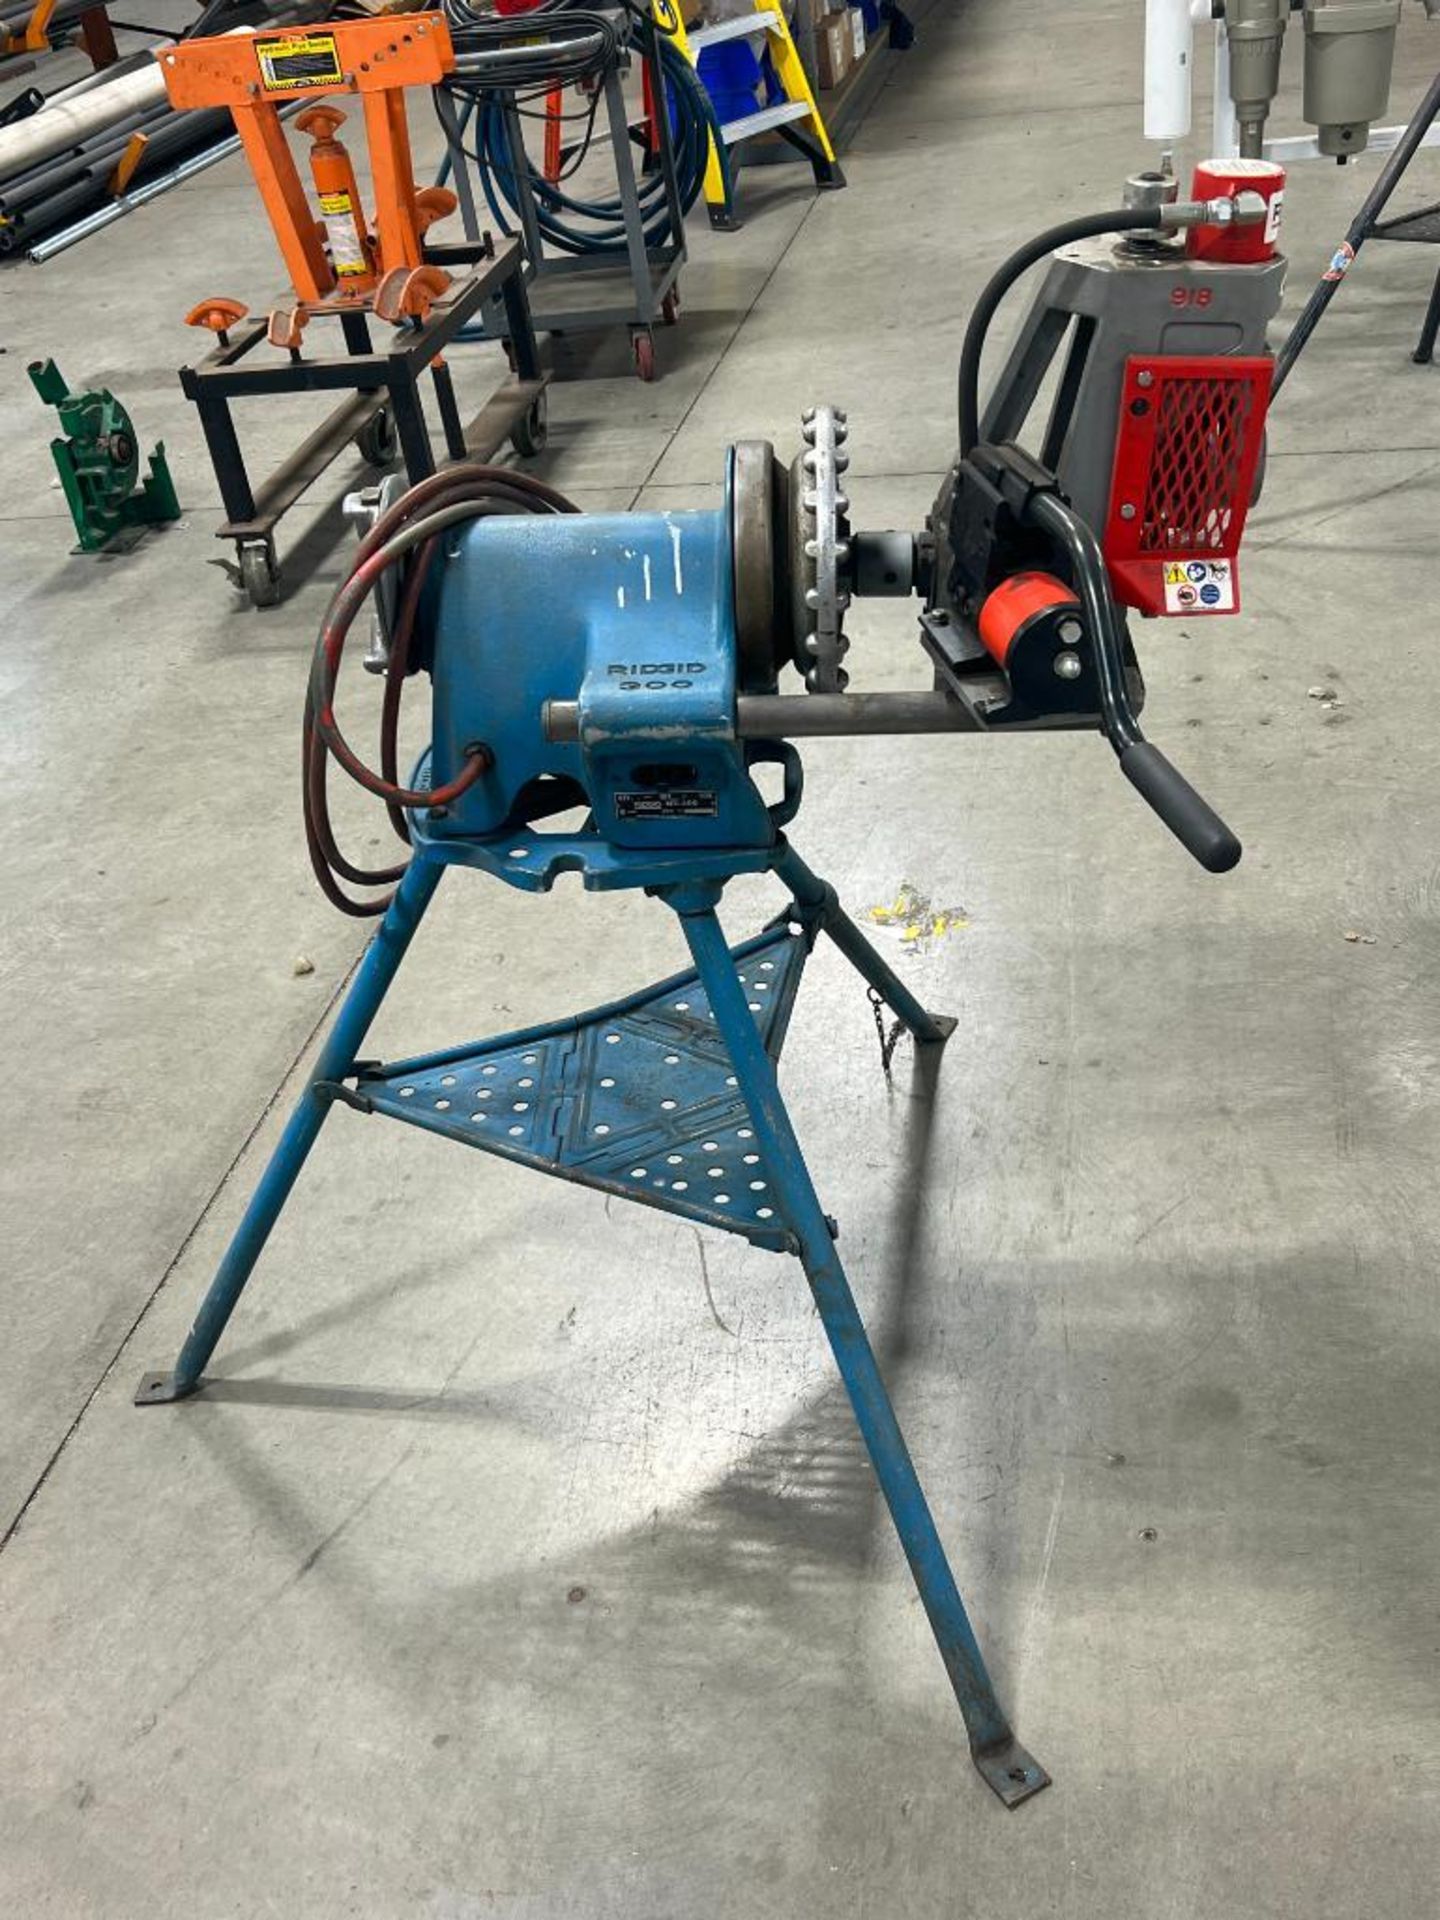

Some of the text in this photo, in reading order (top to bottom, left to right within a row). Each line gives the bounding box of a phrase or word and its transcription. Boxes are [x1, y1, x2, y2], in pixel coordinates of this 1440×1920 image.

[1171, 287, 1214, 307] 918
[607, 663, 706, 676] RIDGID
[619, 680, 693, 690] 300
